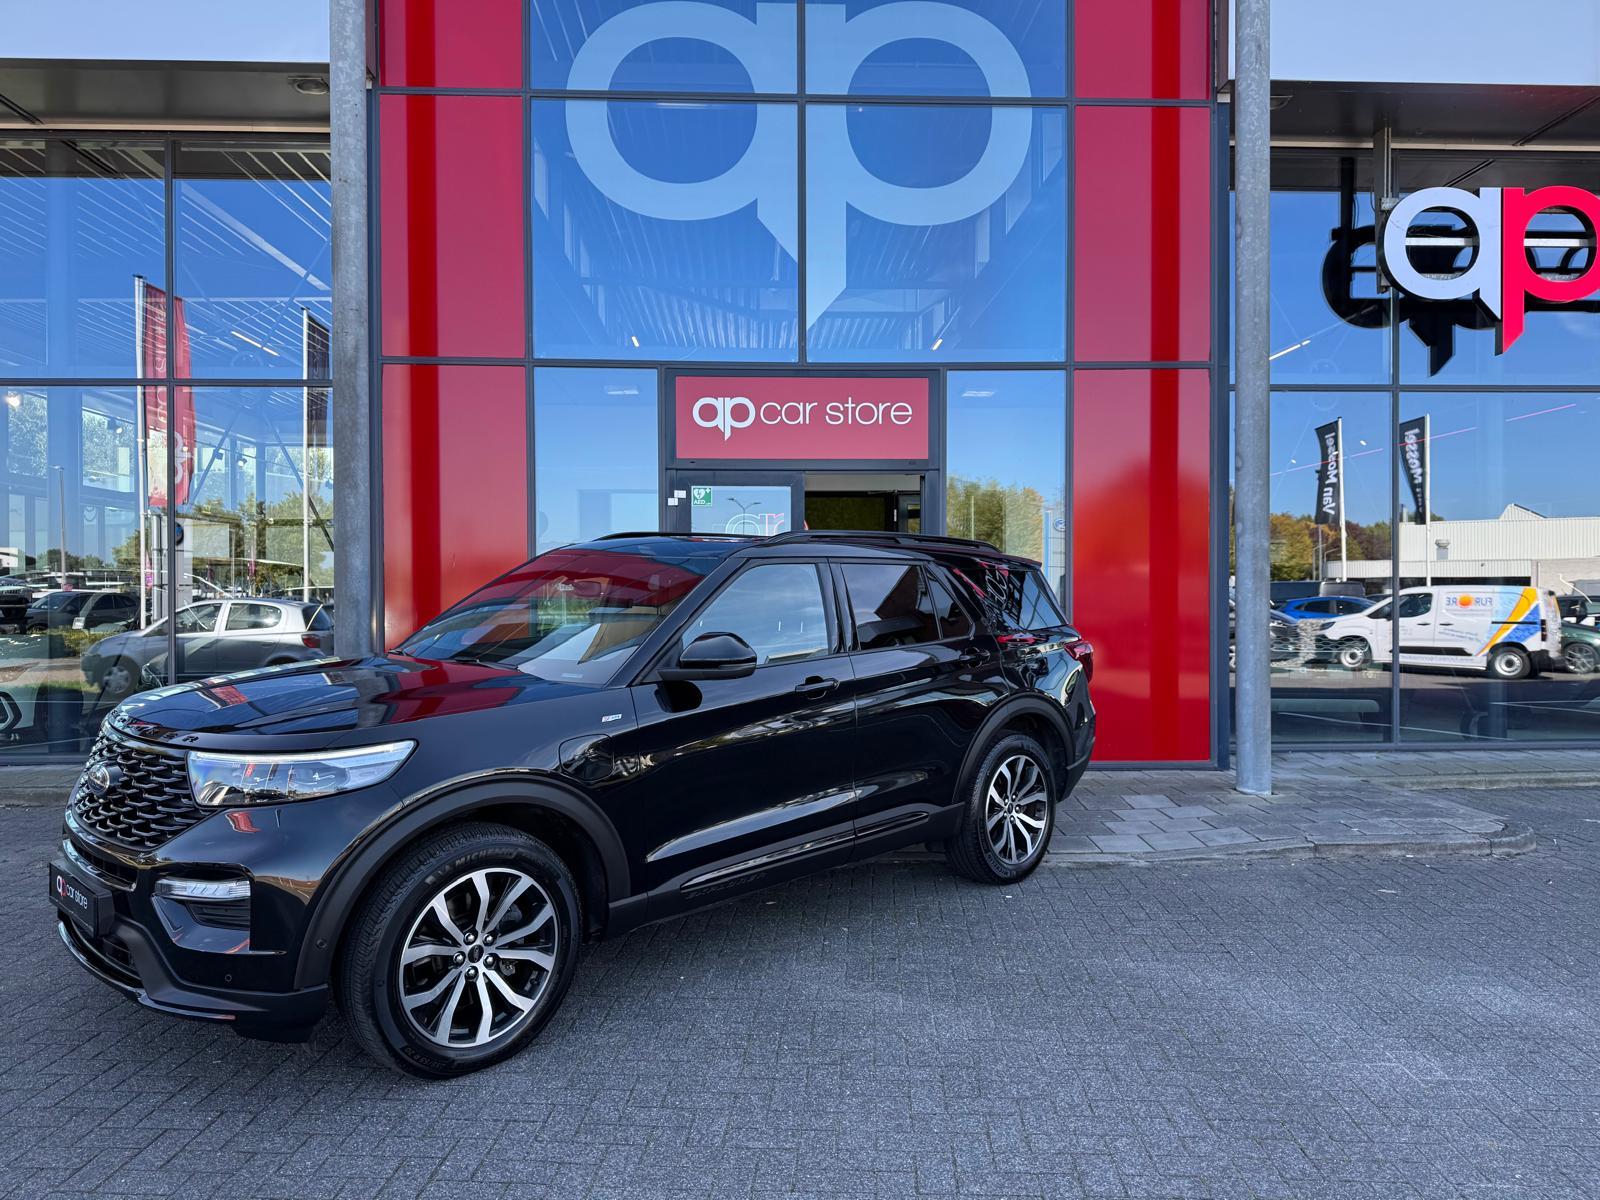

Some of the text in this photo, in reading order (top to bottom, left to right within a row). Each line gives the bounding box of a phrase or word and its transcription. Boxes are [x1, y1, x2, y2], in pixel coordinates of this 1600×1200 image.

[1384, 186, 1600, 354] ap
[692, 396, 913, 441] ap car store
[67, 884, 75, 899] car
[75, 890, 88, 909] store
